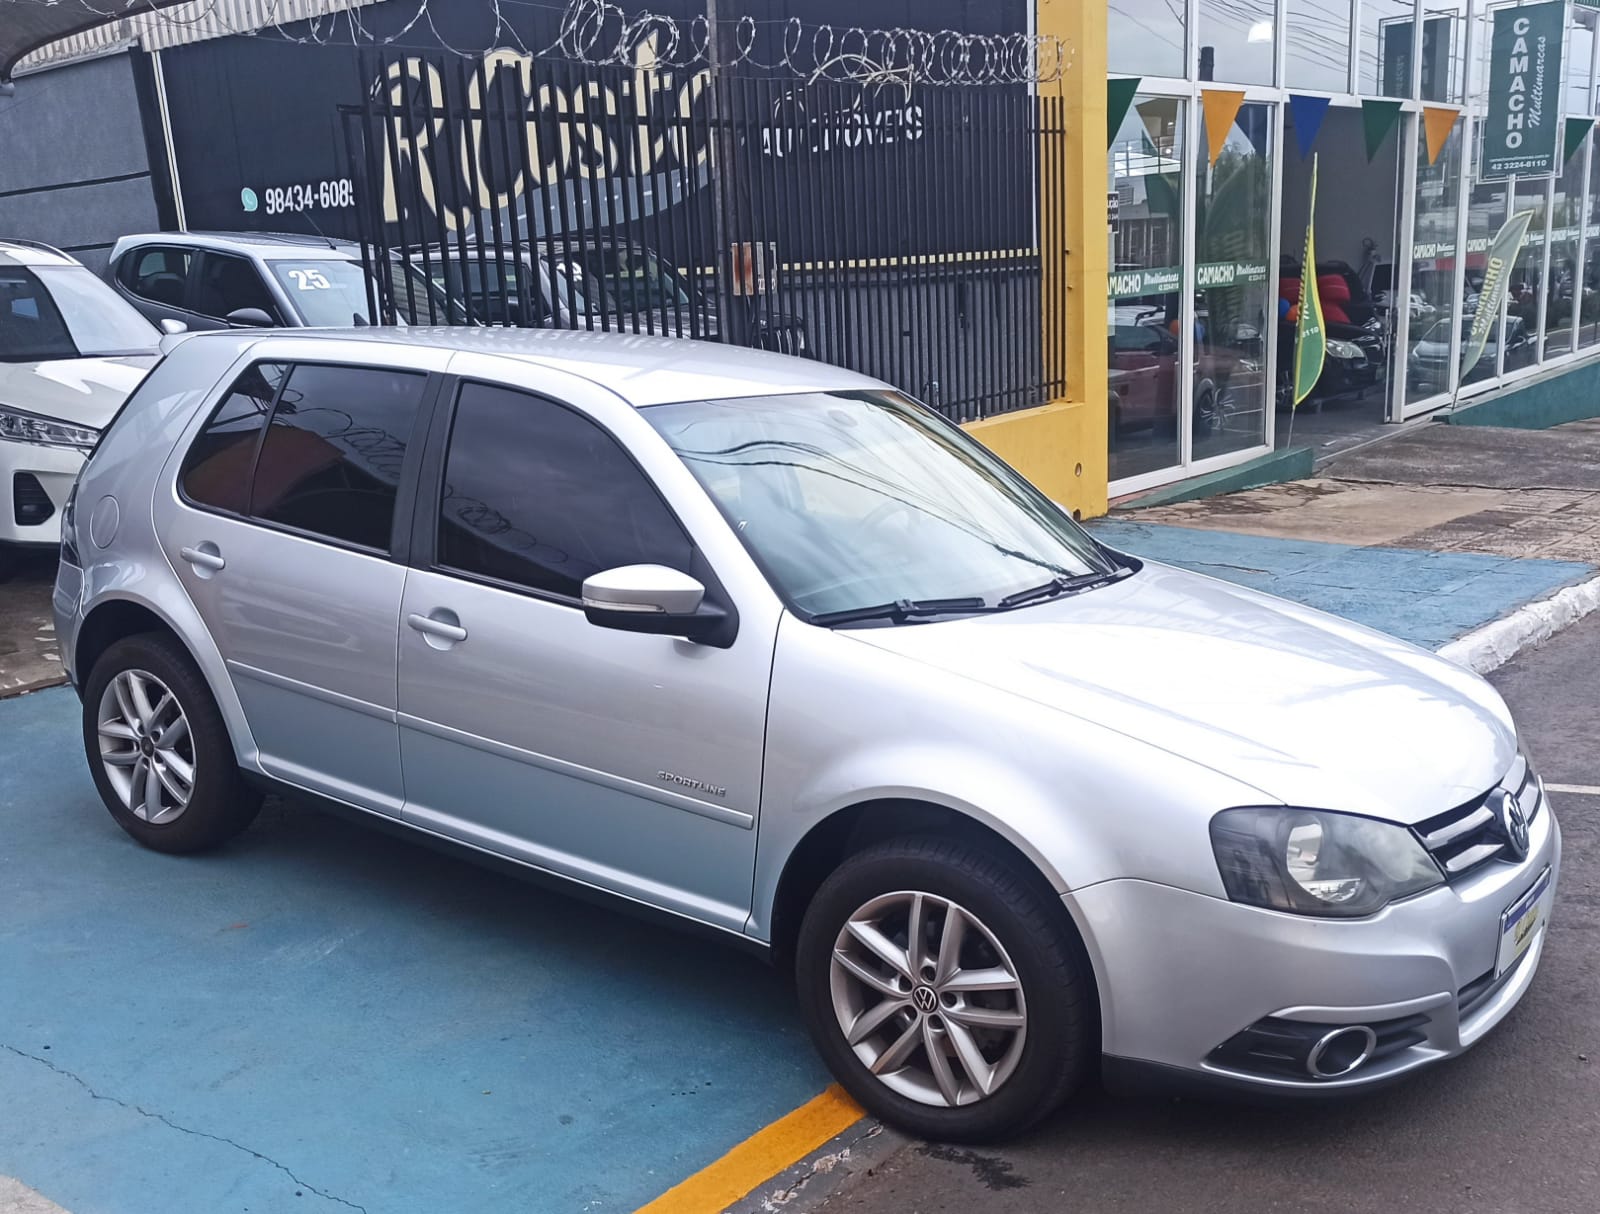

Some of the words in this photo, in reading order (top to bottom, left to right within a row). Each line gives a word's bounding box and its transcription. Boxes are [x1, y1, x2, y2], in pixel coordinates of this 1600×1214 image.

[1505, 17, 1530, 149] CAMACHO
[1527, 36, 1547, 129] Multimarcas
[288, 269, 331, 290] 25
[1197, 264, 1235, 285] CAMACHO
[656, 770, 727, 797] SPORTLINE
